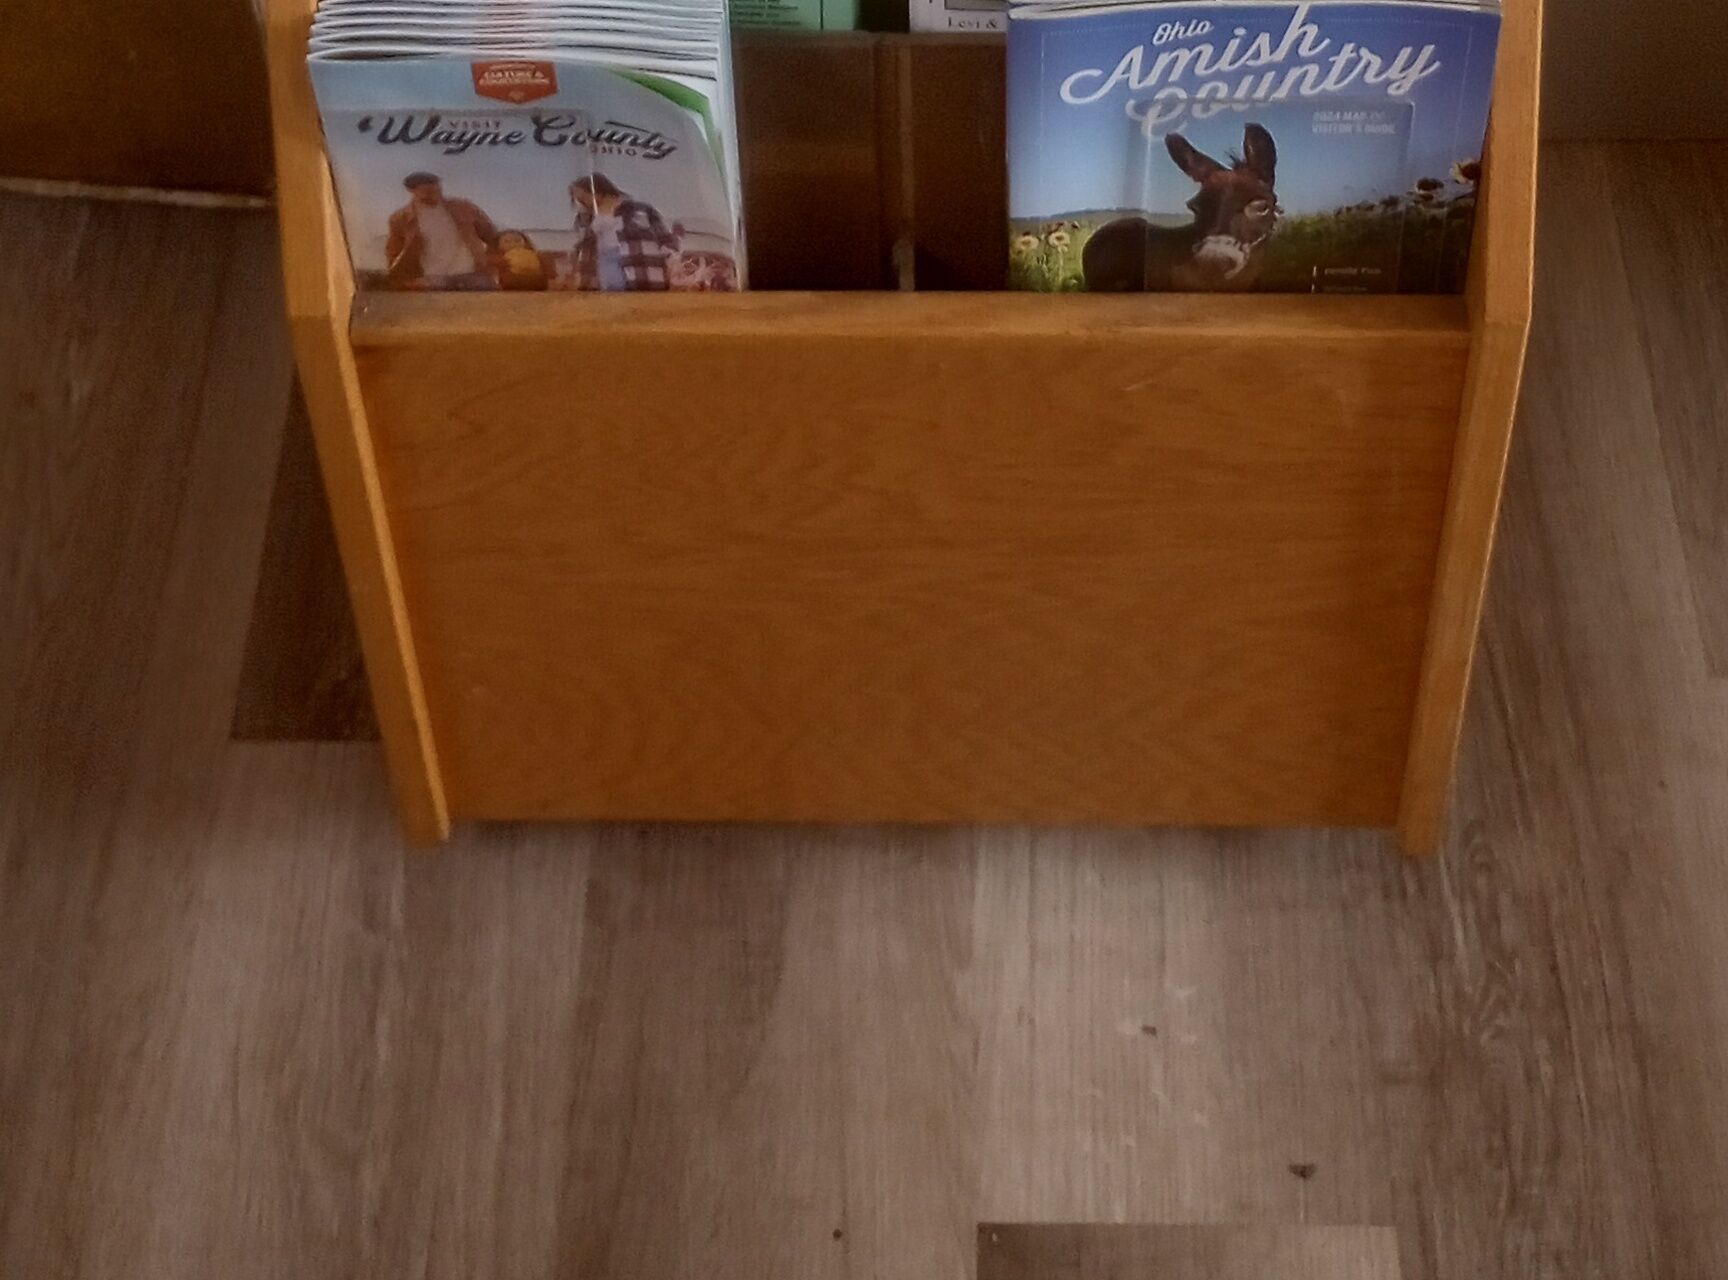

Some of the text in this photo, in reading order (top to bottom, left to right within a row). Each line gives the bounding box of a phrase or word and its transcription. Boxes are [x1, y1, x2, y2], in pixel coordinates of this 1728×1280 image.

[1059, 3, 1333, 105] Amish
[1152, 19, 1215, 46] Ohio
[1125, 42, 1442, 140] Country
[358, 113, 679, 160] Wayne County
